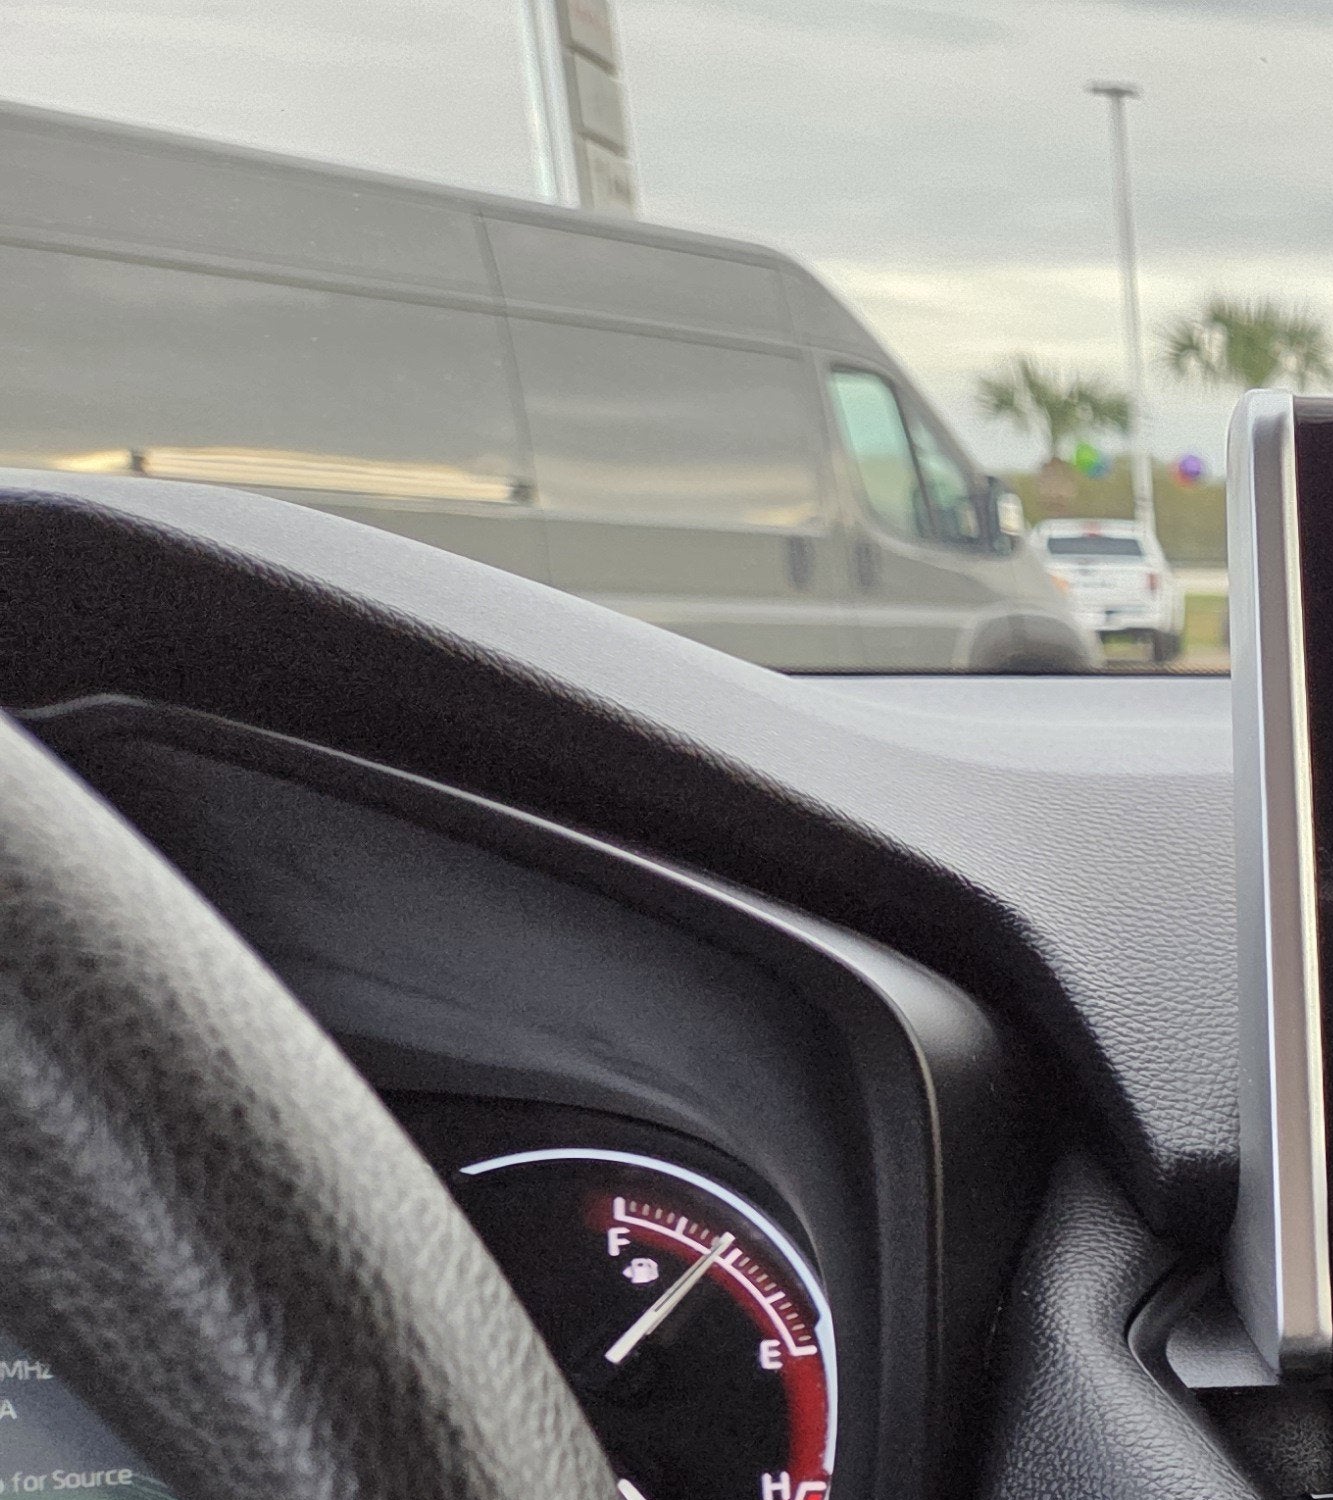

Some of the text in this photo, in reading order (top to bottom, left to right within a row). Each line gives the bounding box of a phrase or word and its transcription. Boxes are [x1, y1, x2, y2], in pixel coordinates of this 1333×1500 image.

[607, 1226, 631, 1257] F
[760, 1339, 783, 1370] E
[12, 1472, 47, 1493] for
[51, 1468, 133, 1490] Source
